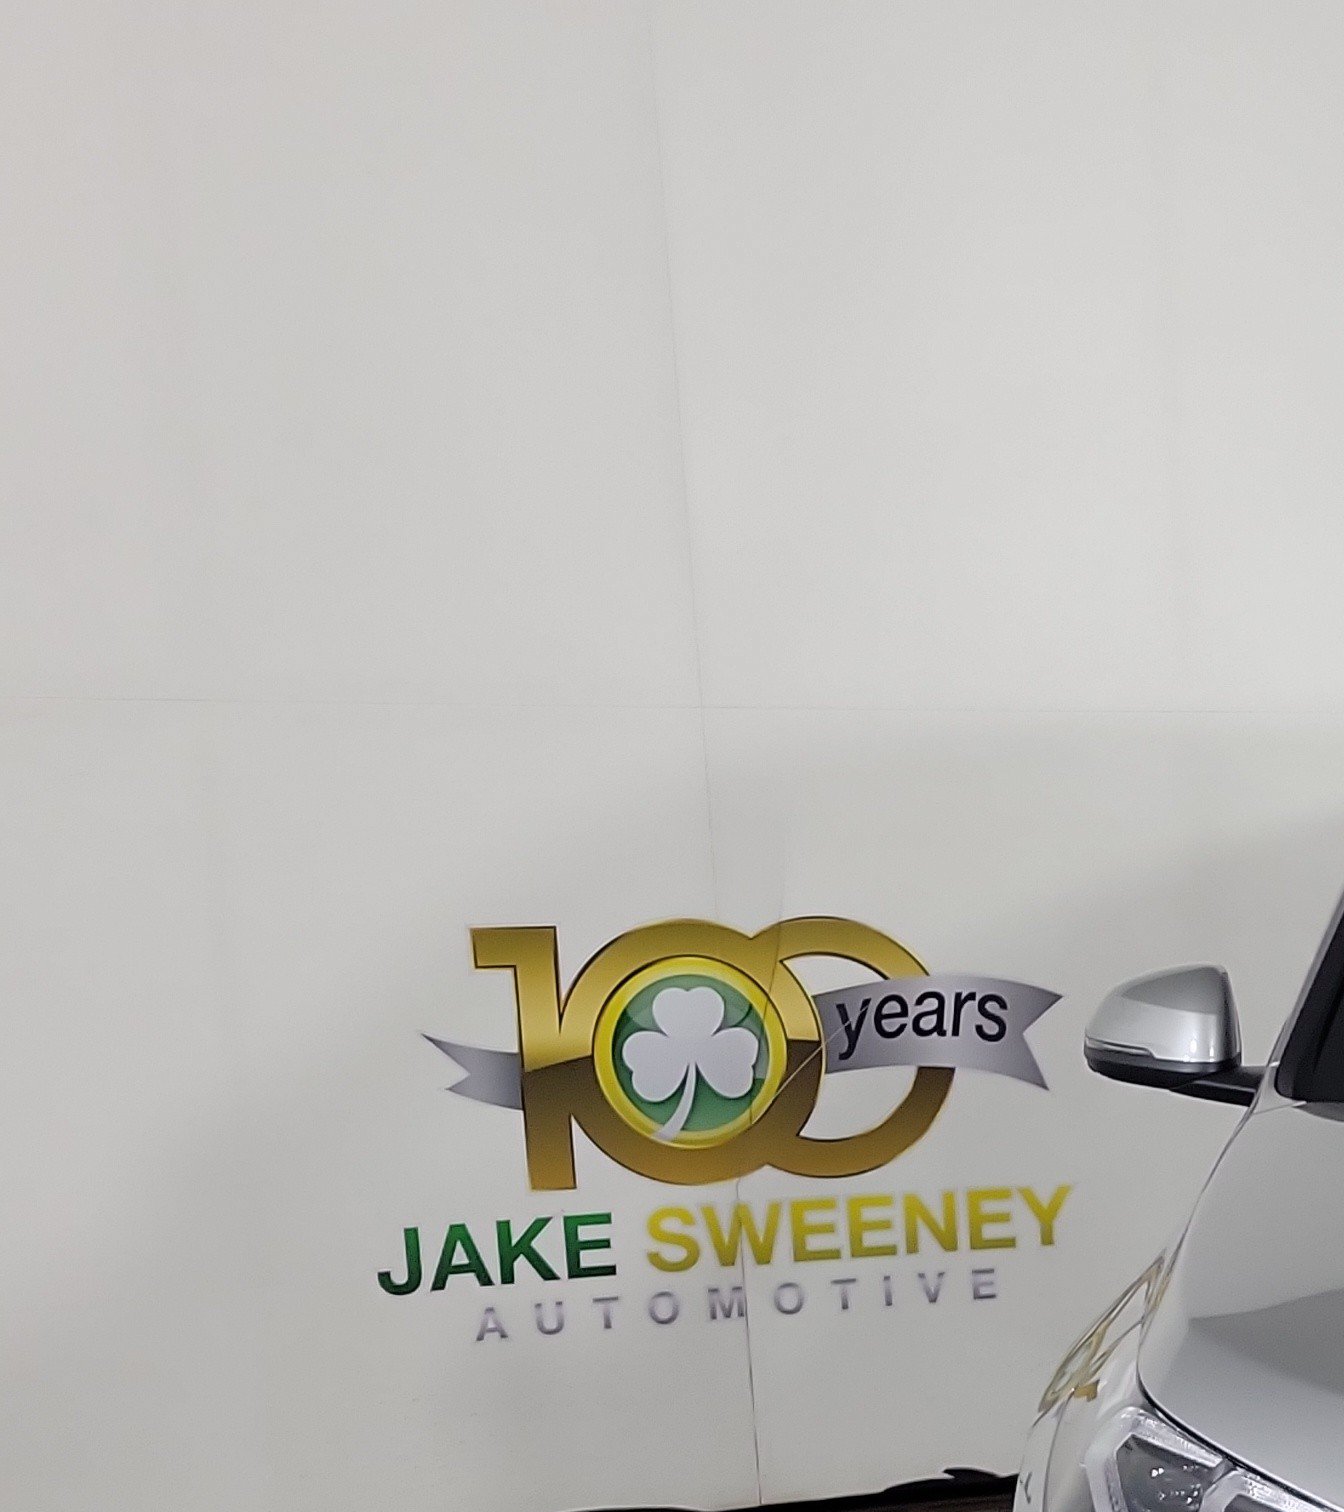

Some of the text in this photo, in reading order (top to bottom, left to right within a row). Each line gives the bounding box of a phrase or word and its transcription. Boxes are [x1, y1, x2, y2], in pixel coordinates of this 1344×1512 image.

[836, 990, 1009, 1060] years
[377, 1185, 1073, 1296] JAKE SWEENEY
[475, 1267, 998, 1343] AUTOMOTIVE
